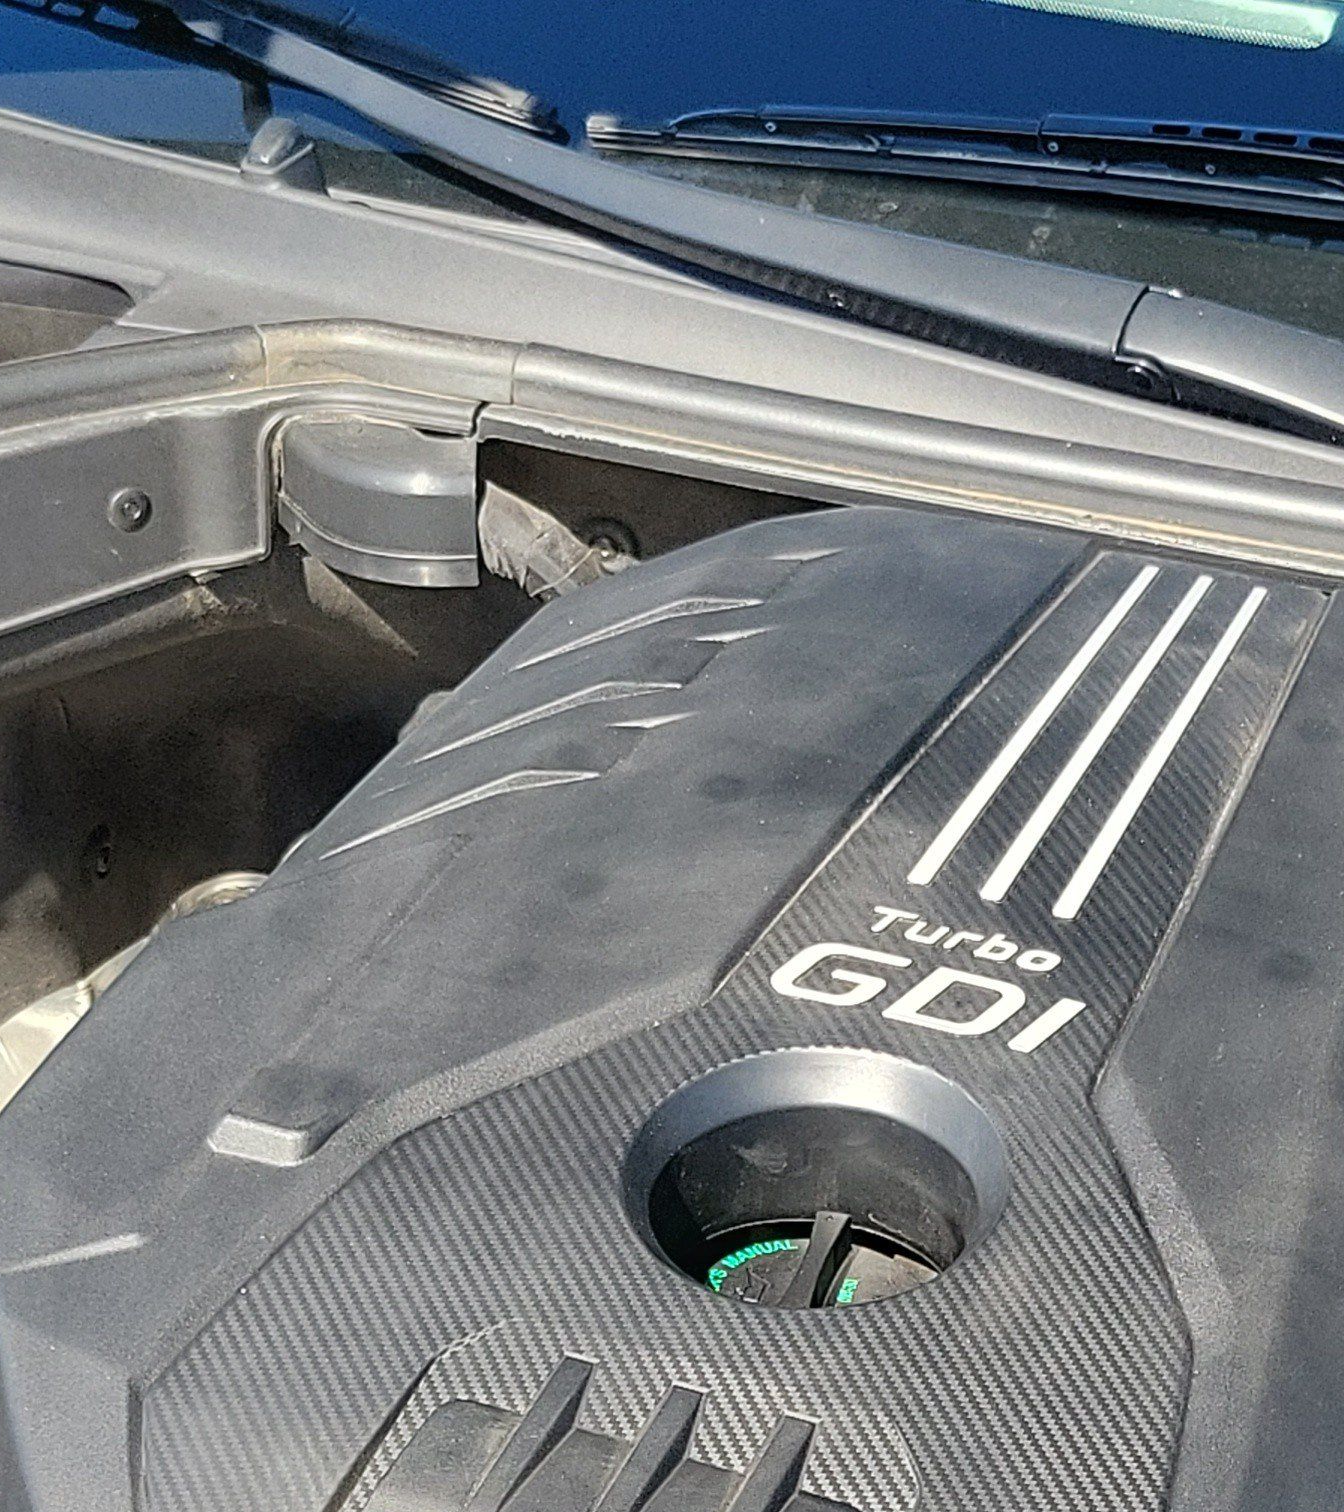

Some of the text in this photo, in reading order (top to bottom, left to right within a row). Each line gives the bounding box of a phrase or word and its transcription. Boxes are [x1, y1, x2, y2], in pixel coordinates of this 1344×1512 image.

[870, 906, 1062, 973] Turbo
[771, 942, 1087, 1054] GDI
[721, 1238, 799, 1270] MANUAL
